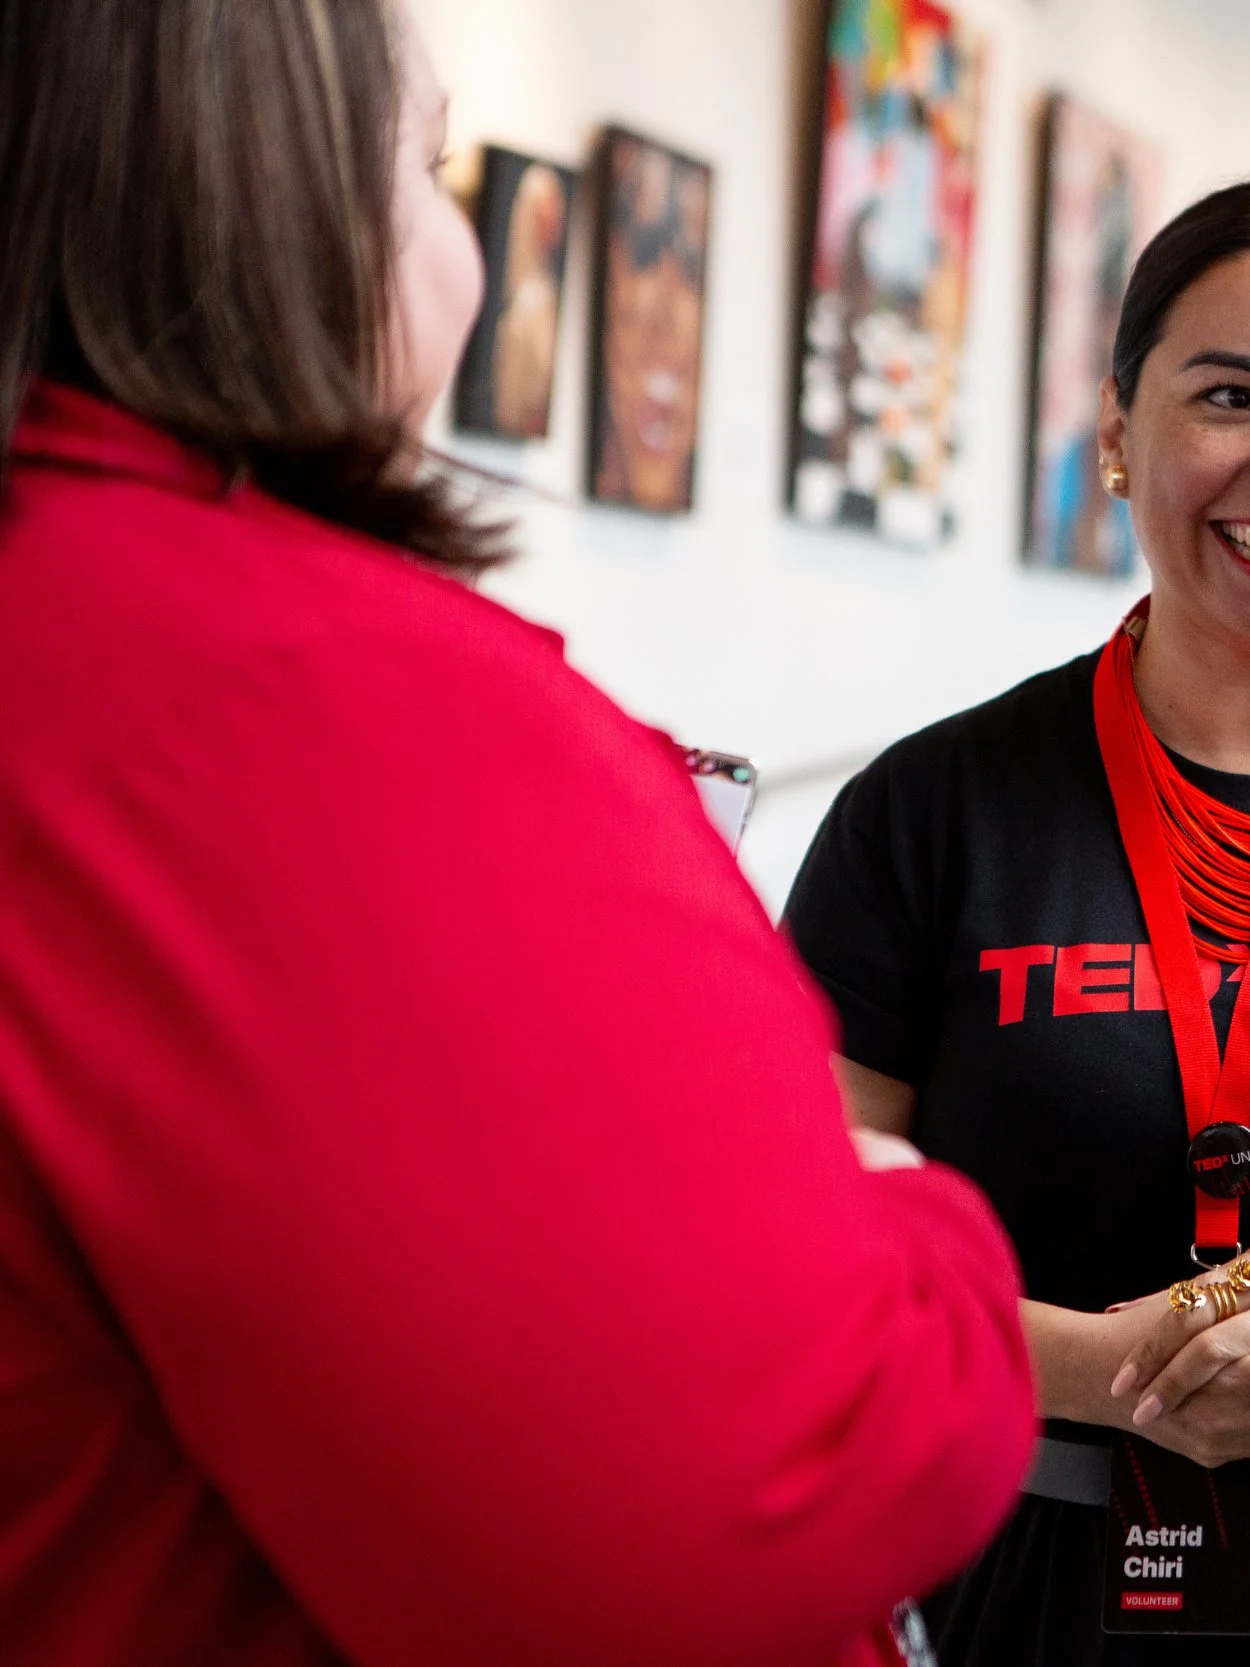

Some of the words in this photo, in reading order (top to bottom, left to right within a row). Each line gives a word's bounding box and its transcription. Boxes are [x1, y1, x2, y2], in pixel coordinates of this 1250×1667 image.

[1125, 1524, 1203, 1547] Astrid
[1123, 1556, 1183, 1578] Chiri
[1125, 1596, 1179, 1606] VOLUNTEER
